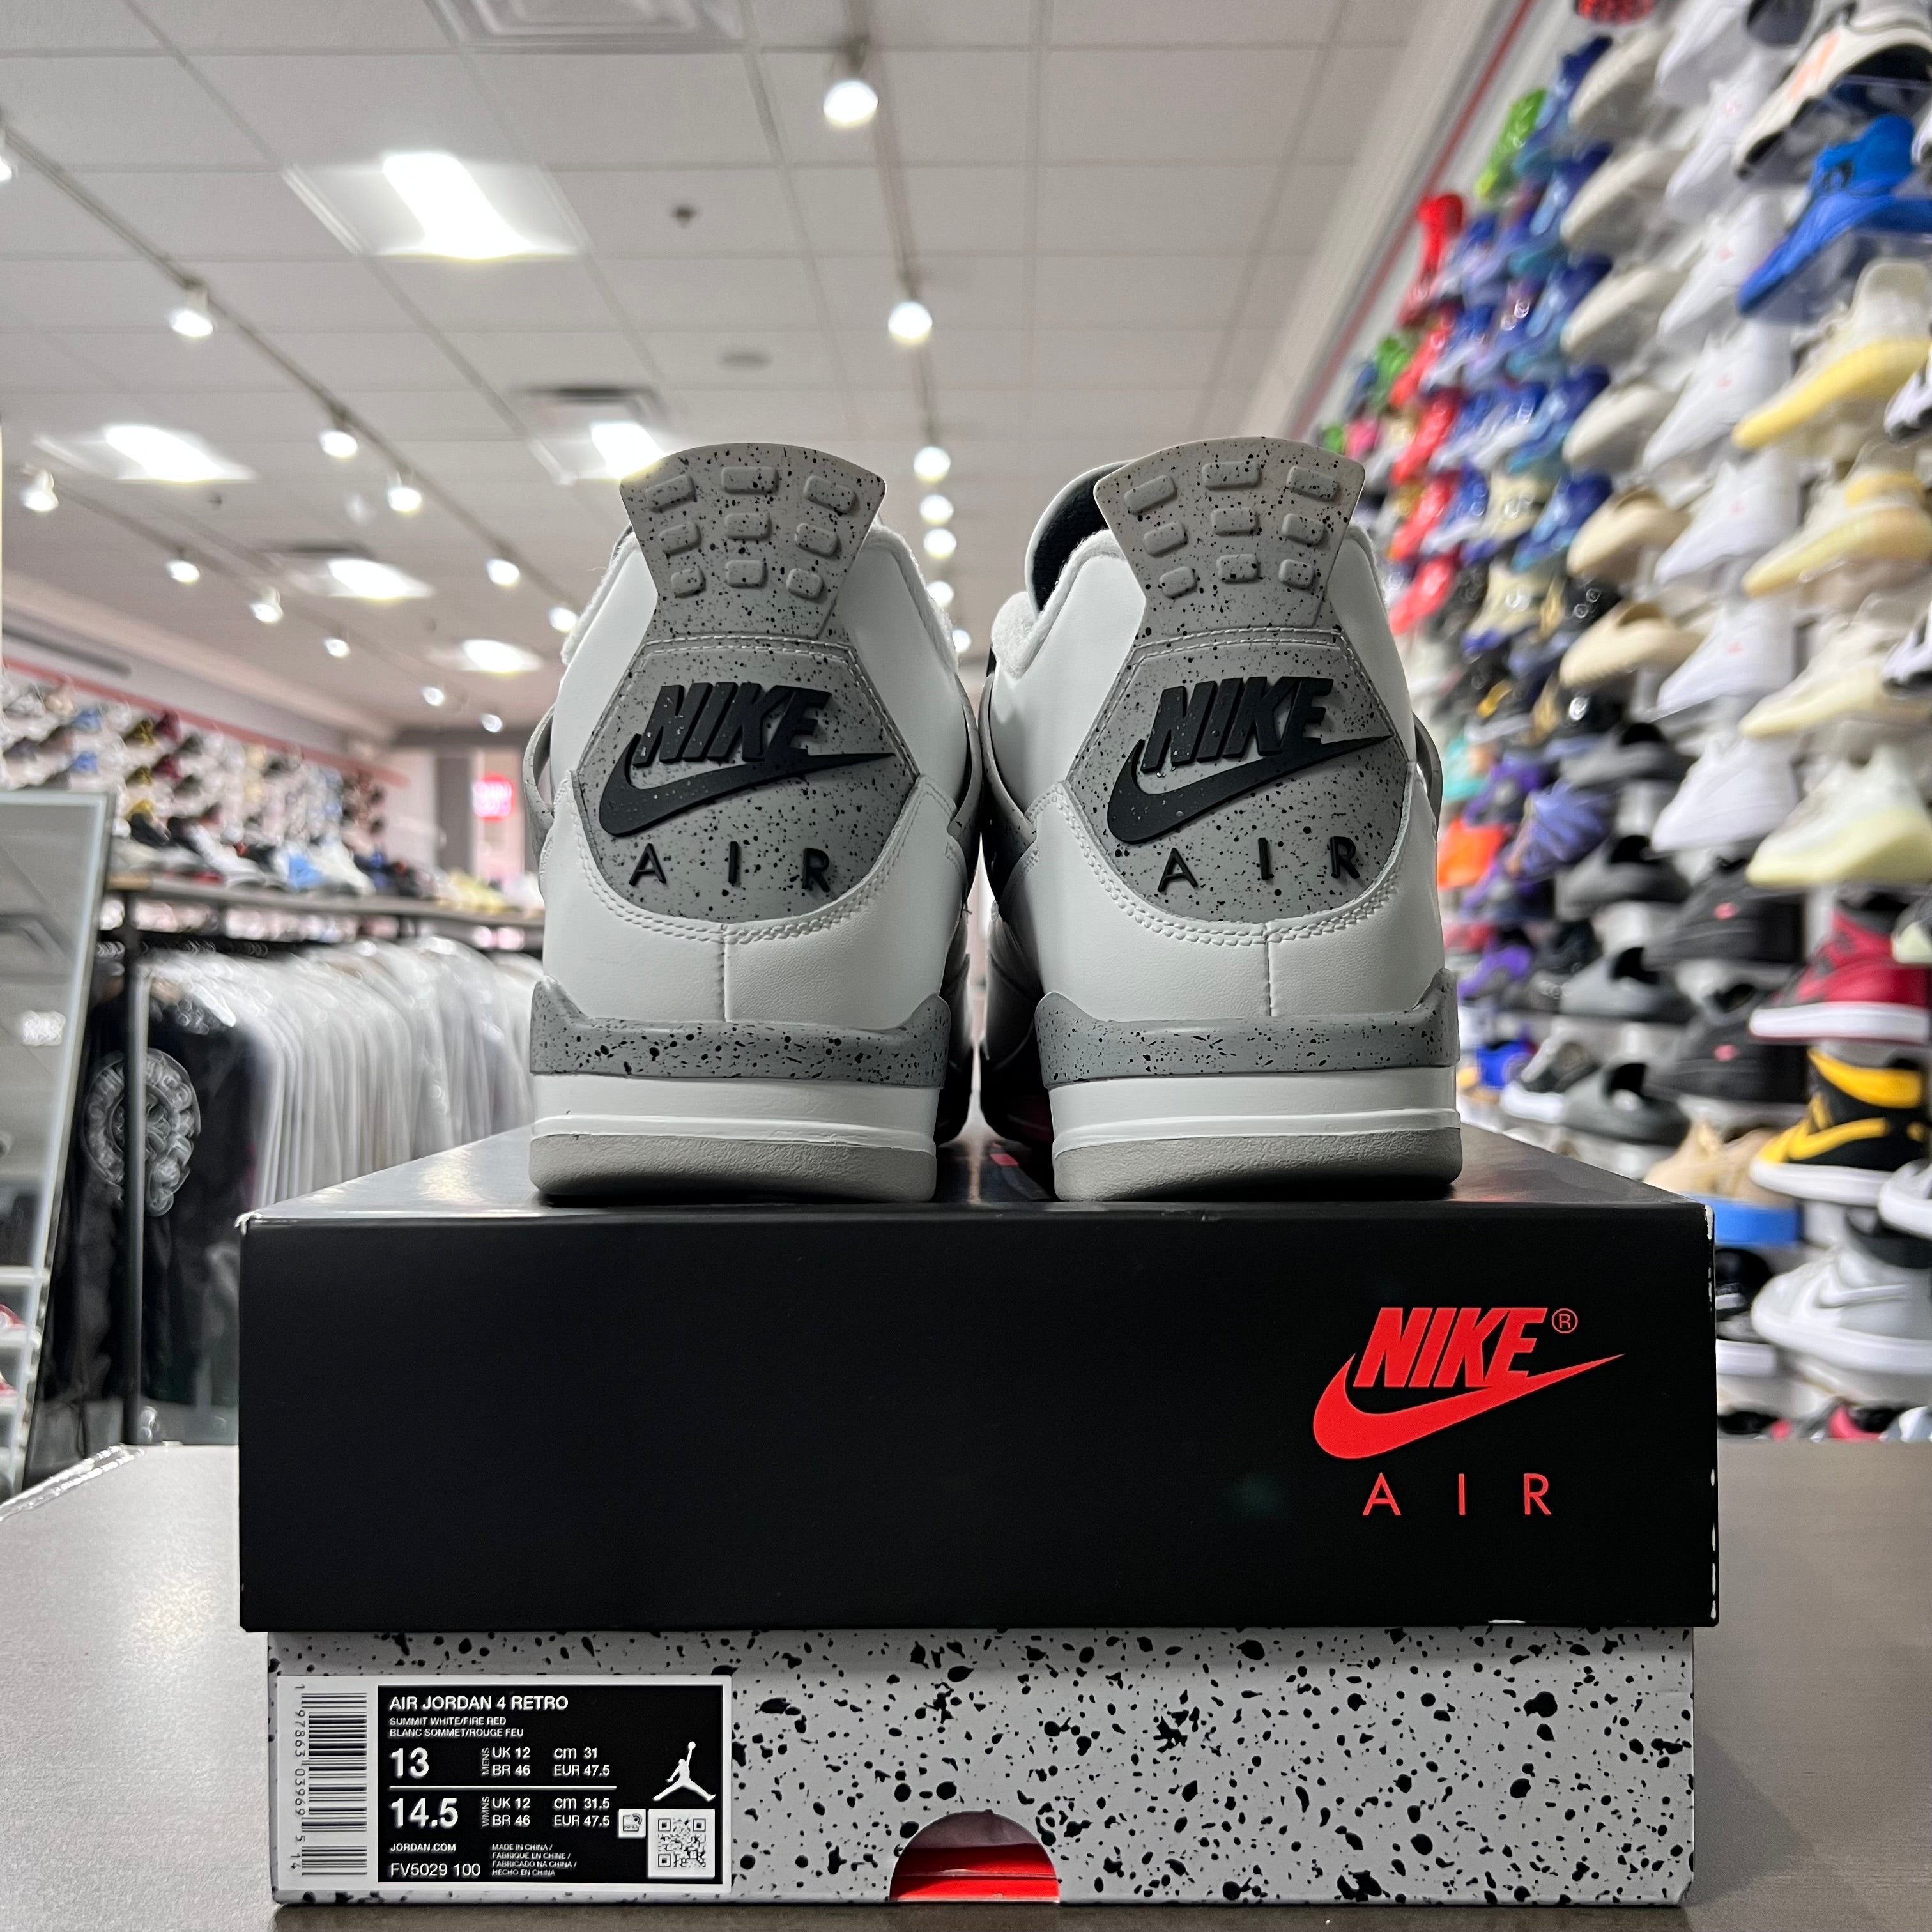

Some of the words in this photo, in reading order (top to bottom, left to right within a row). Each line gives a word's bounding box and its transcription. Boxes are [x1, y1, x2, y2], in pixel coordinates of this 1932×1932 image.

[632, 682, 832, 767] NIKE
[1141, 677, 1334, 774] NIKE
[628, 841, 831, 892] AIR
[1157, 836, 1361, 892] AIR
[1352, 1307, 1549, 1388] NIKE
[1362, 1471, 1552, 1516] AIR
[389, 1696, 418, 1711] AIR
[422, 1696, 492, 1711] JORDAN
[496, 1696, 507, 1710] 4
[510, 1696, 569, 1710] RETRO
[389, 1717, 428, 1726] SUMMIT
[430, 1717, 485, 1726] WHITE/FIRE
[486, 1717, 507, 1726] RED
[295, 1710, 306, 1757] 97863
[389, 1728, 422, 1737] BLANC
[424, 1728, 503, 1738] SOMMET/ROUGE
[505, 1728, 524, 1737] FEU
[493, 1747, 511, 1759] UK
[515, 1747, 531, 1759] 12
[553, 1747, 577, 1759] cm
[583, 1747, 597, 1759] 31
[390, 1747, 429, 1778] 13
[482, 1747, 490, 1775] MENS
[492, 1764, 511, 1776] BR
[514, 1764, 531, 1776] 46
[553, 1764, 580, 1777] EUR
[583, 1765, 610, 1777] 47.5
[295, 1768, 306, 1816] 03969
[492, 1797, 511, 1809] UK
[515, 1797, 531, 1810] 12
[553, 1798, 577, 1810] cm
[584, 1797, 610, 1810] 31.5
[390, 1797, 459, 1828] 14.5
[482, 1796, 490, 1827] WMNS
[492, 1814, 511, 1827] BR
[515, 1814, 531, 1827] 46
[554, 1814, 580, 1827] EUR
[583, 1815, 610, 1827] 47.5
[390, 1843, 456, 1852] JORDAN.COM
[390, 1862, 448, 1877] FV5029
[453, 1863, 481, 1876] 100
